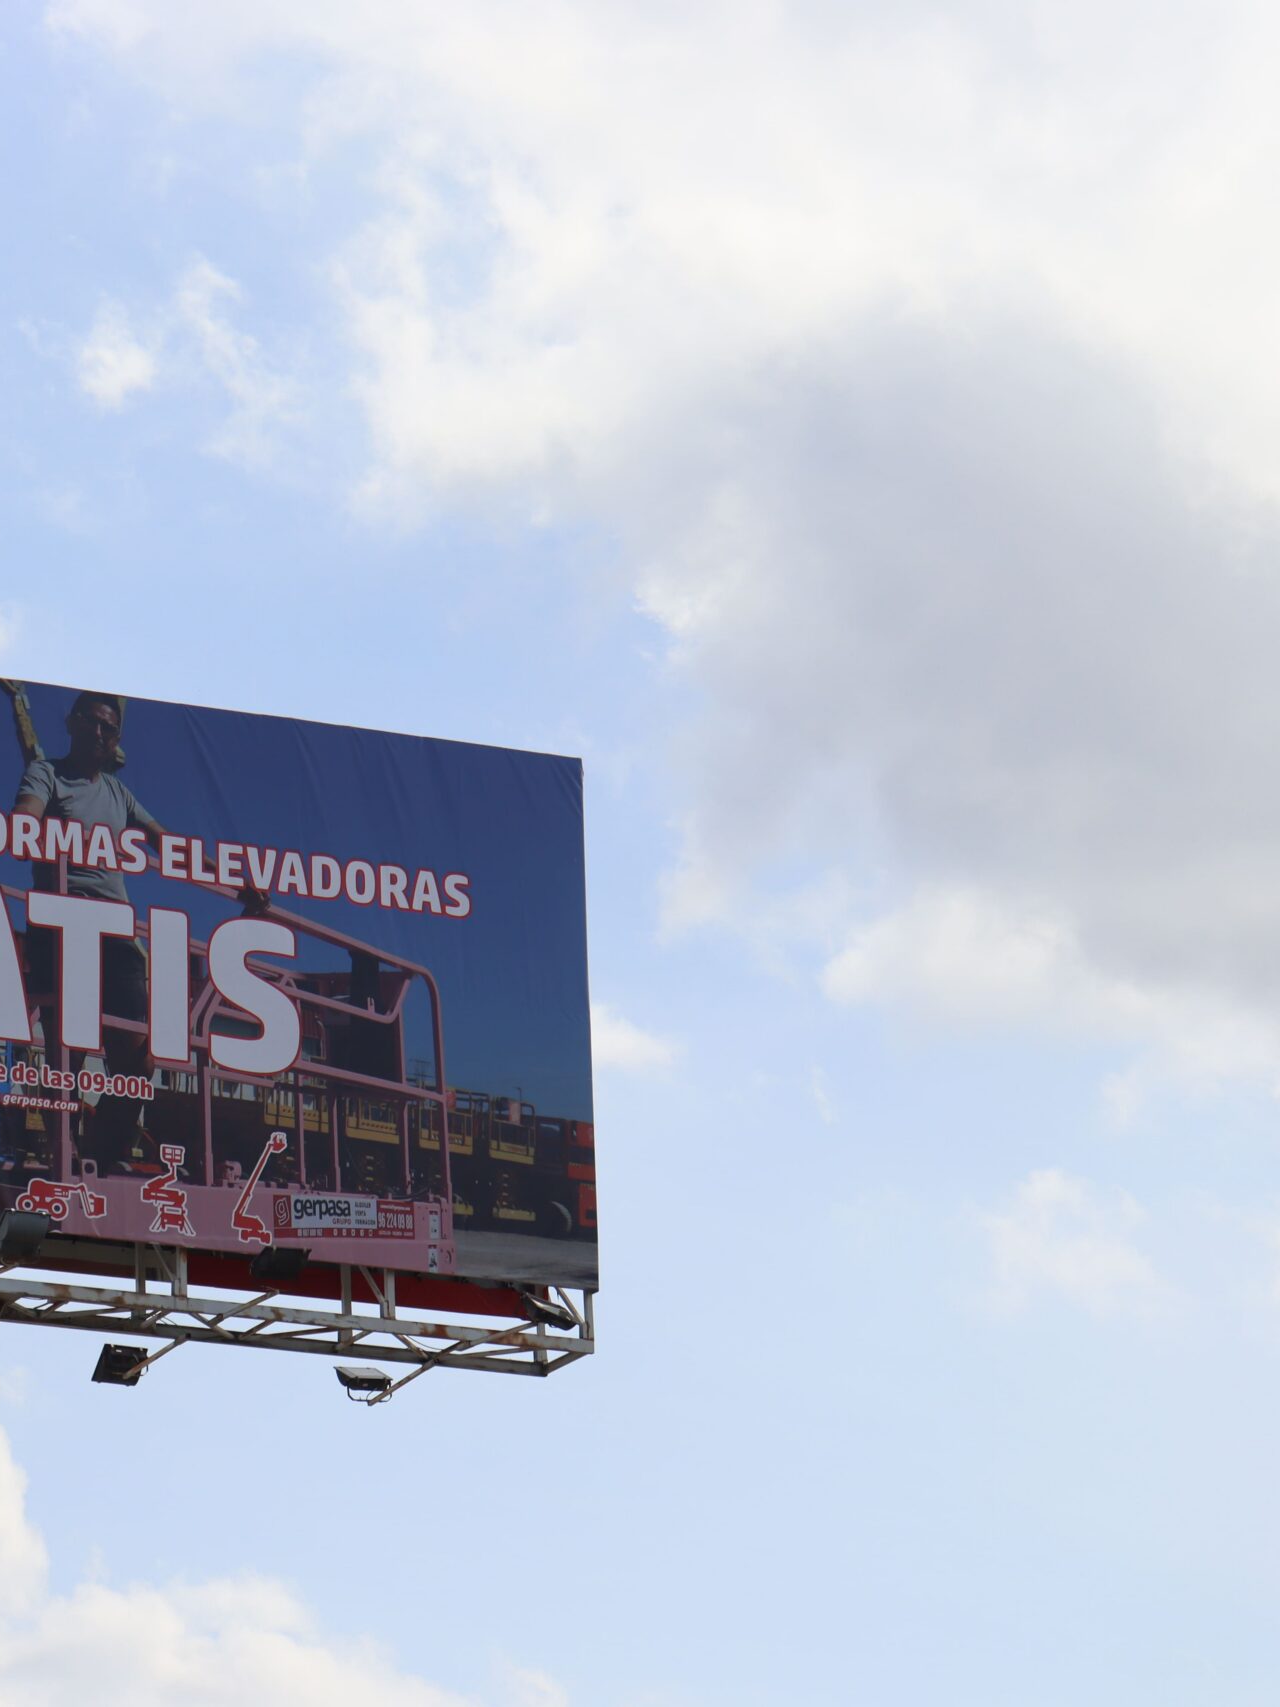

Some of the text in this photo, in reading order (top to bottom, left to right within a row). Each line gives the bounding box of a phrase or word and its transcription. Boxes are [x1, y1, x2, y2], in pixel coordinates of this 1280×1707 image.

[161, 833, 471, 918] ELEVADORAS
[11, 1061, 39, 1085] de
[41, 1064, 75, 1090] las
[78, 1070, 155, 1101] 09:00h
[2, 1093, 79, 1112] gerpasa.com
[293, 1198, 352, 1220] gerpasa
[331, 1217, 352, 1225] GRUPO
